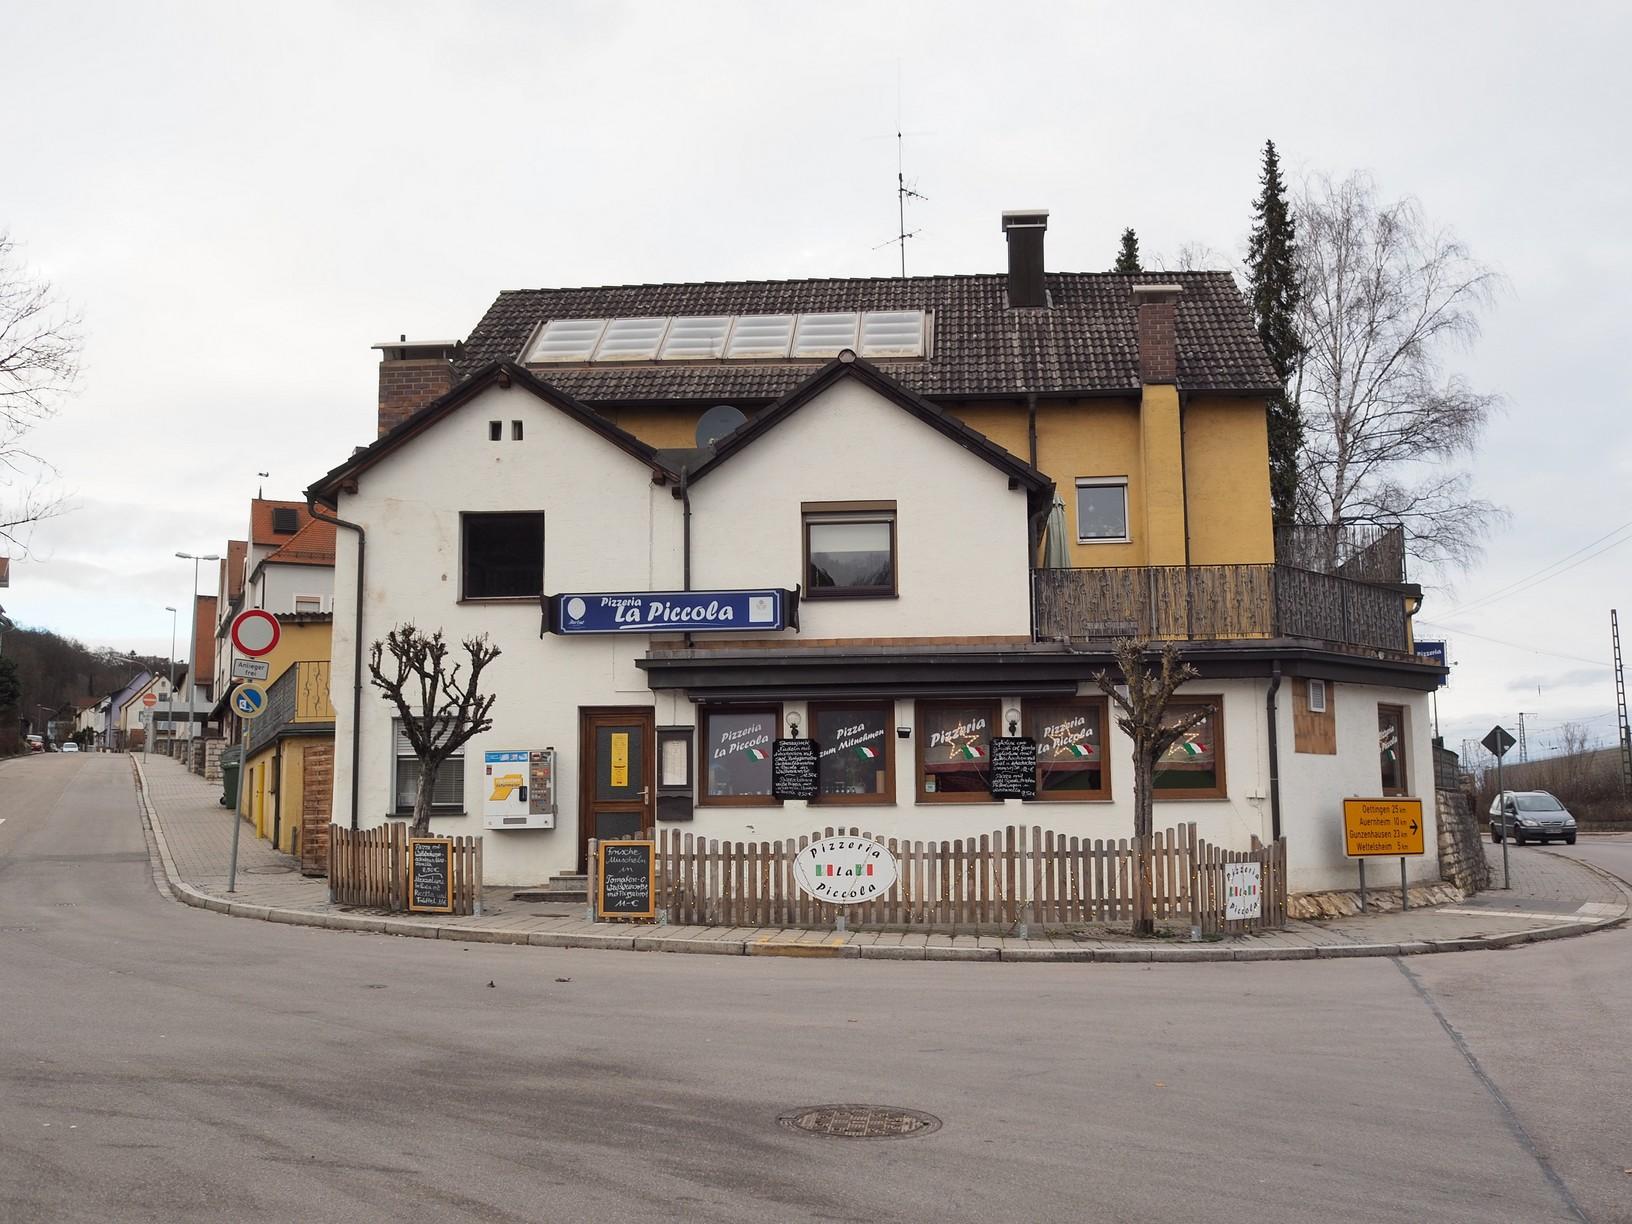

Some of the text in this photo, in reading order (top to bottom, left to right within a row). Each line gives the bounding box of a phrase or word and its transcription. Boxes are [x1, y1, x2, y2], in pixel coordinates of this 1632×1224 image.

[600, 597, 641, 608] Pizzeria
[614, 600, 734, 622] La Piccola
[1416, 648, 1442, 656] Pizzeria
[721, 724, 762, 743] Pizzeria
[836, 723, 864, 740] Pizza
[930, 718, 986, 748] Pizzeria
[1044, 716, 1085, 738] Pizzeria
[714, 748, 726, 758] La
[729, 734, 768, 754] Piccola
[820, 730, 884, 758] zum Mitnehmen
[1038, 728, 1093, 754] La Piccola
[1362, 804, 1390, 815] Oettingen
[1392, 804, 1398, 814] 25
[1360, 818, 1390, 826] Auernheim
[1394, 817, 1400, 826] 10
[1350, 830, 1392, 838] Gunzenhausen
[1393, 830, 1400, 838] 23
[810, 842, 880, 858] Pizzeria
[1357, 842, 1392, 850] Wettelsheim
[1397, 842, 1400, 850] 5
[836, 866, 853, 876] La
[816, 882, 876, 898] Piccola
